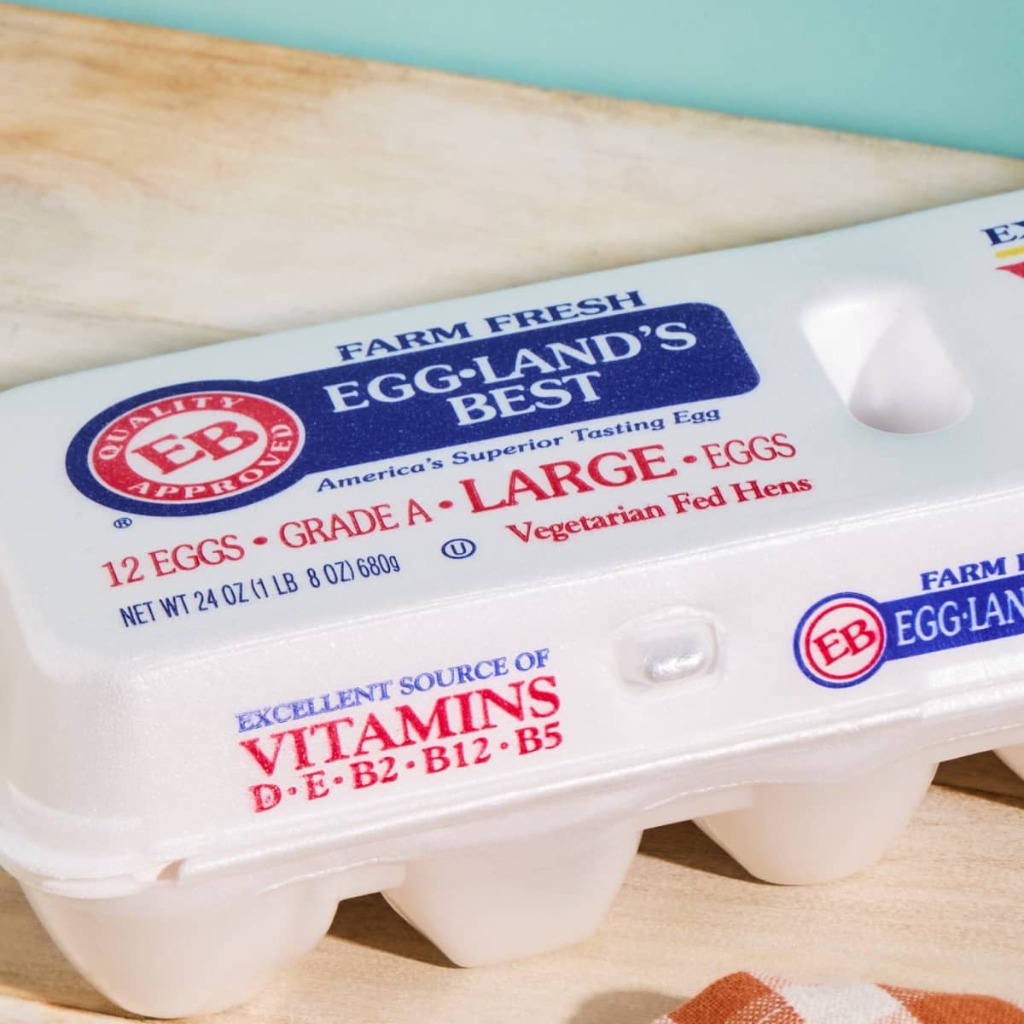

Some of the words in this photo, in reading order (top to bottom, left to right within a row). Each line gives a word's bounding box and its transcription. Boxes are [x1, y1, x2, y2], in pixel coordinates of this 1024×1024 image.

[336, 321, 474, 361] FARM
[486, 290, 646, 333] FRESH
[99, 396, 244, 461] QUALITY
[447, 371, 601, 427] BEST
[127, 422, 292, 500] APPROVED
[130, 420, 261, 475] EB
[316, 455, 443, 491] America's
[451, 435, 564, 470] Superior
[570, 416, 665, 443] Tasting
[673, 407, 720, 428] Egg
[102, 555, 144, 588] 12
[148, 534, 245, 577] EGGS
[279, 504, 399, 549] GRADE
[407, 499, 432, 526] A
[459, 444, 678, 513] LARGE
[700, 433, 797, 470] EGGS
[506, 504, 665, 543] Vegetarian
[669, 488, 727, 515] Fed
[732, 476, 812, 504] Hens
[119, 600, 156, 628] NET
[160, 594, 190, 618] WT
[194, 589, 218, 612] 24
[222, 581, 248, 606] OZ
[251, 576, 264, 600] (1
[272, 571, 299, 595] LB
[307, 567, 320, 589] 8
[327, 559, 354, 584] OZ)
[357, 554, 401, 580] 680g
[920, 556, 1007, 591] FARM
[813, 618, 876, 666] EB
[234, 680, 393, 733] EXCELLENT
[400, 656, 509, 695] SOURCE
[515, 648, 550, 672] OF
[239, 676, 561, 777] VITAMINS
[250, 783, 282, 813] D
[302, 770, 329, 800] E
[350, 756, 398, 790] B2
[421, 736, 491, 774] B12
[515, 721, 563, 755] B5
